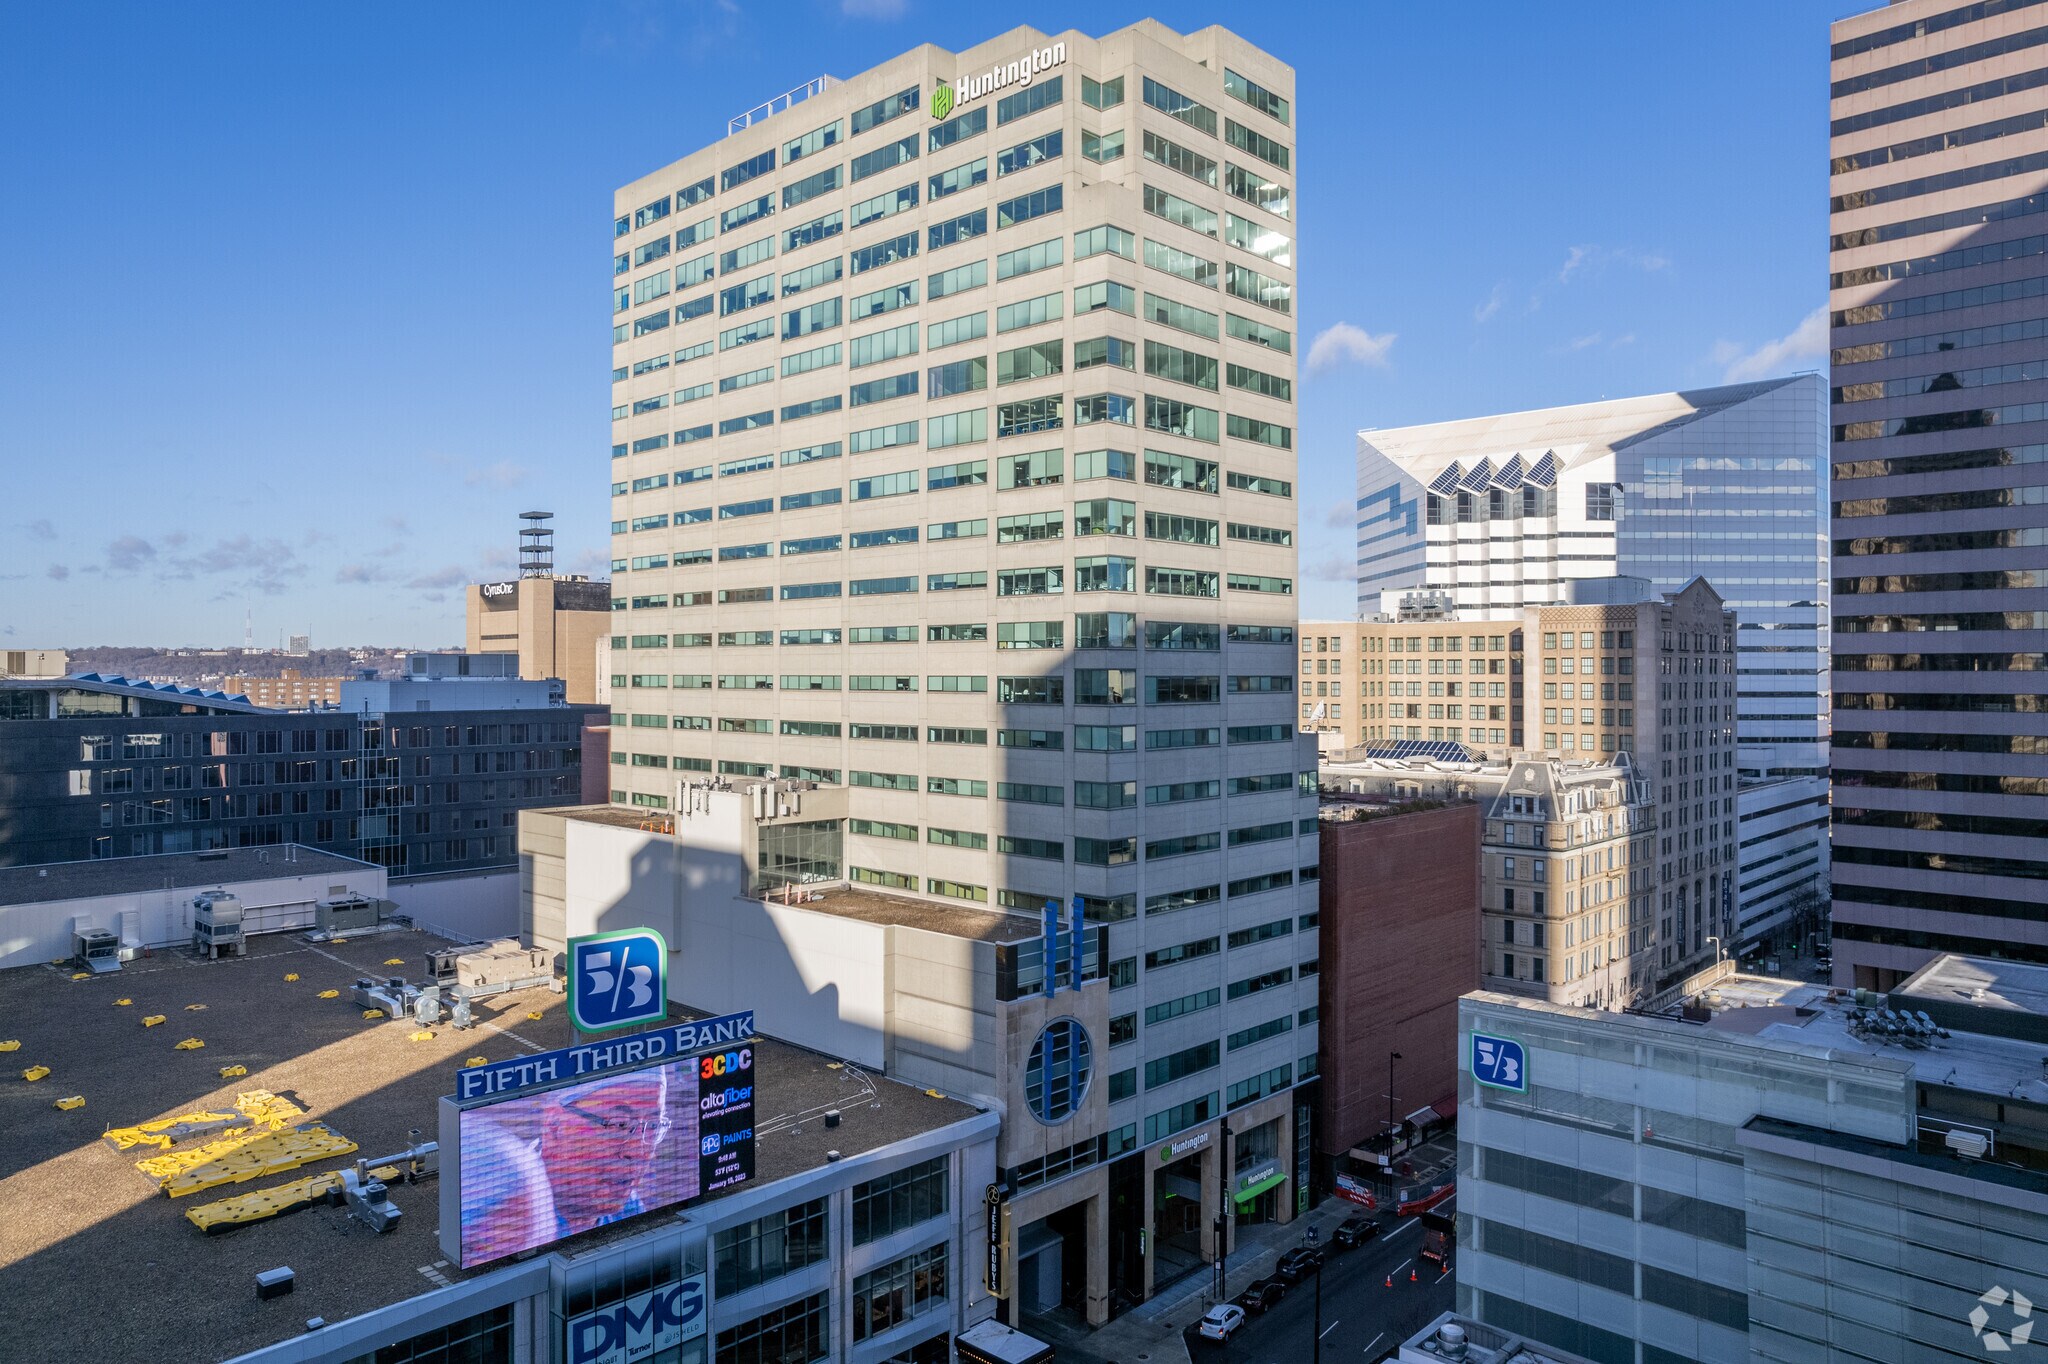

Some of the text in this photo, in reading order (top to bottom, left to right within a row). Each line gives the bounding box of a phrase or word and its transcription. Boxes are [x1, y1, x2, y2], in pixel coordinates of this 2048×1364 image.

[957, 42, 1066, 105] Huntington
[484, 583, 513, 597] CyrusOne
[461, 1017, 753, 1098] FIFTH THIRD BANK
[701, 1049, 752, 1079] 3CDC
[701, 1086, 752, 1110] altafiber
[702, 1101, 751, 1120] elevating connection
[703, 1128, 752, 1152] PPG PAINTS
[1171, 1132, 1208, 1155] Huntington
[1247, 1167, 1274, 1185] Huntington
[573, 1281, 703, 1364] DMG
[628, 1342, 652, 1357] Turner
